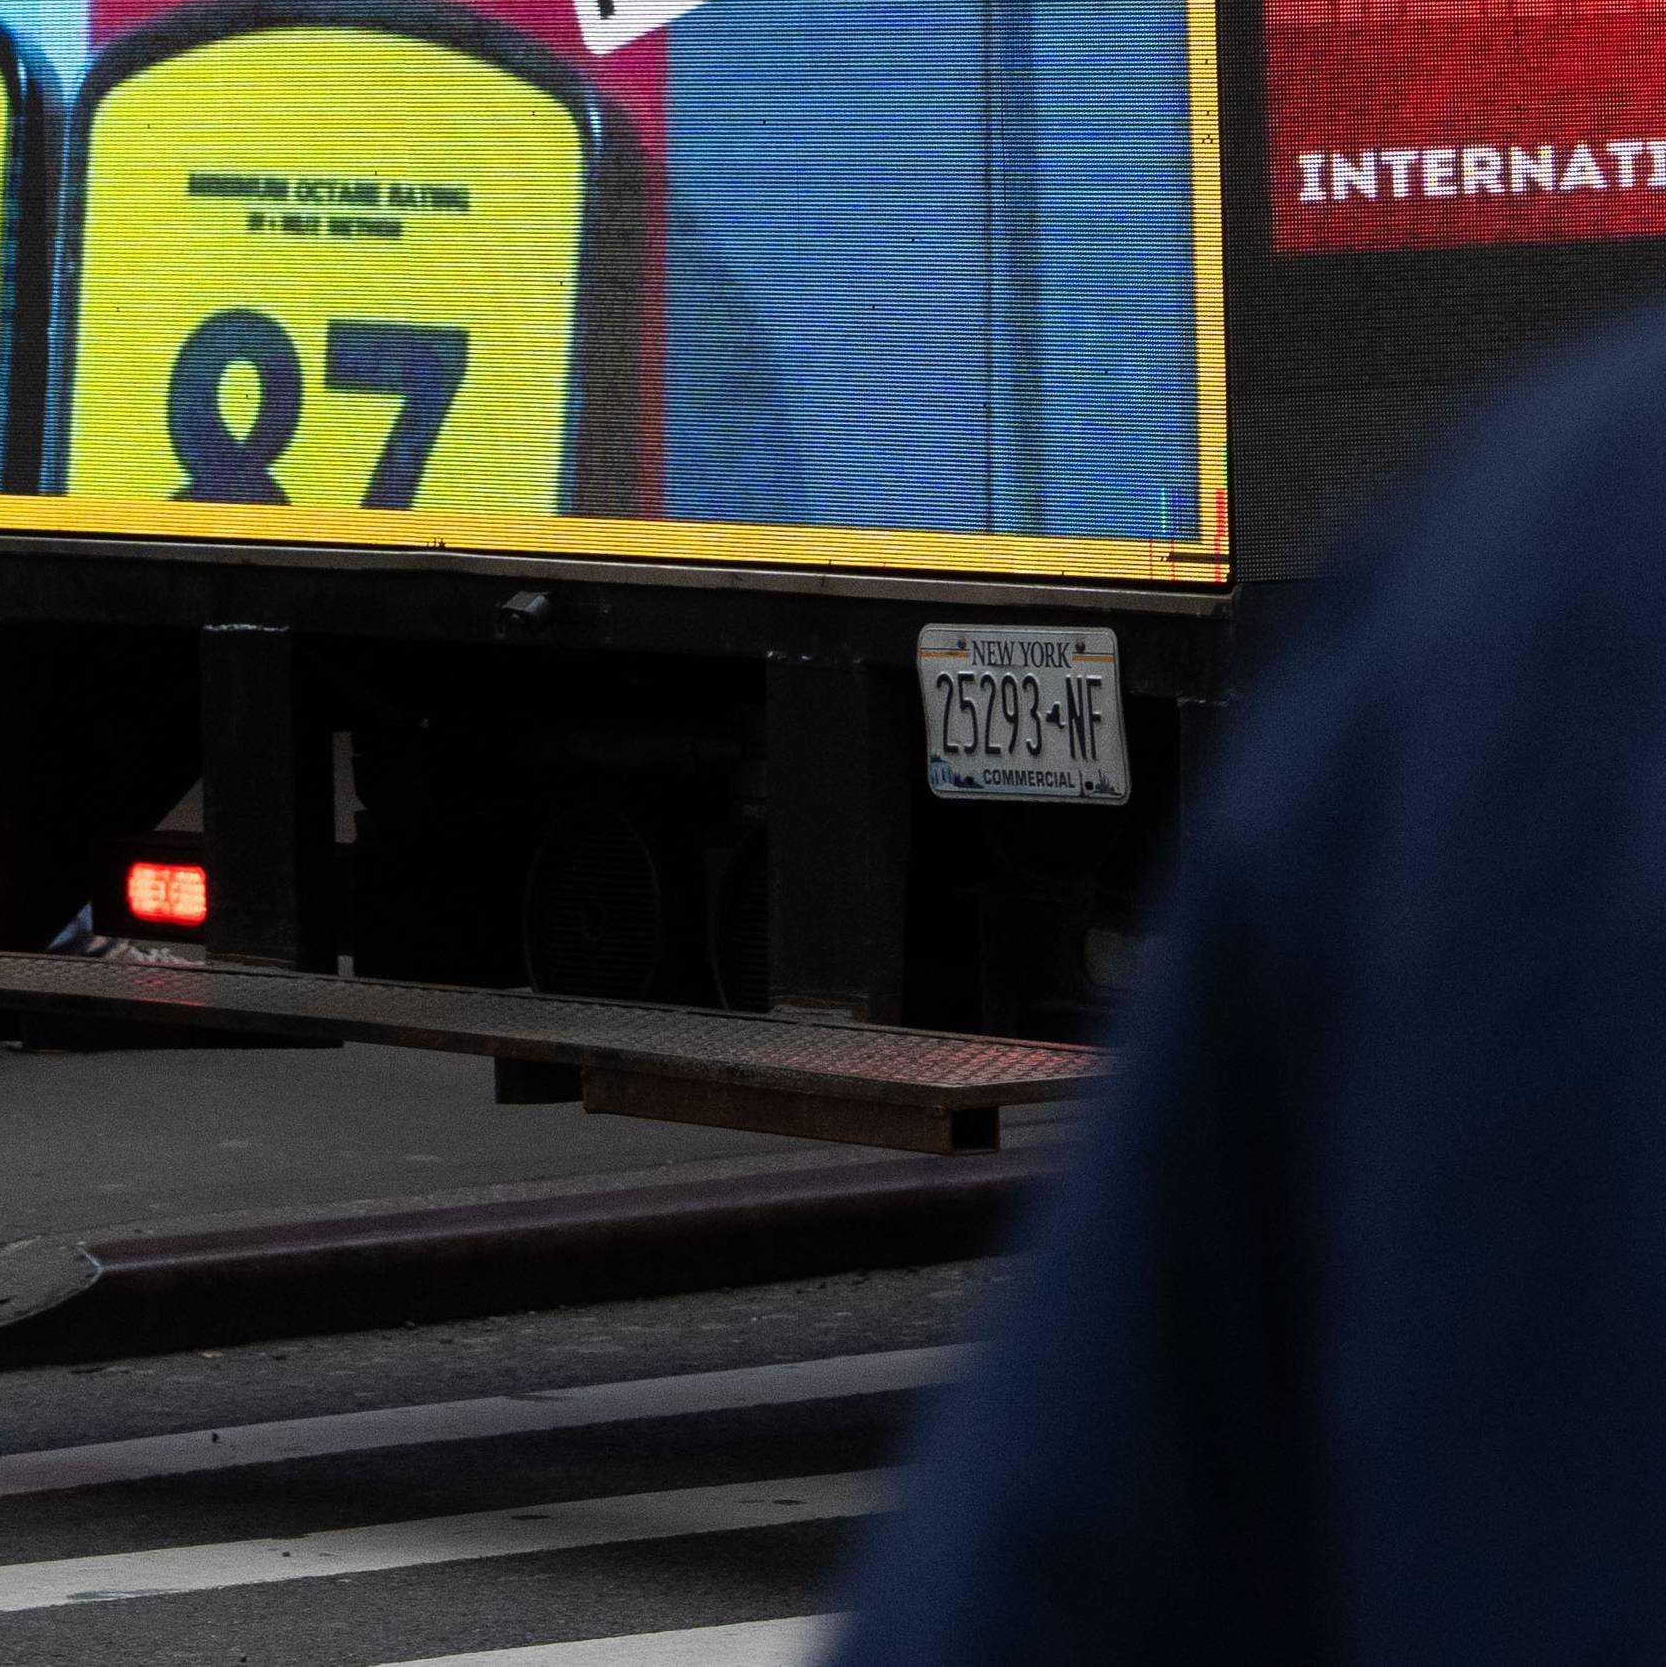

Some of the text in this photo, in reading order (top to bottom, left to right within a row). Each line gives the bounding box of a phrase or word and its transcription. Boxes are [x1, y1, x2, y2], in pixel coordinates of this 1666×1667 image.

[166, 307, 469, 510] 87
[972, 640, 1072, 669] NEW YORK
[983, 768, 1076, 789] COMMERCIAL
